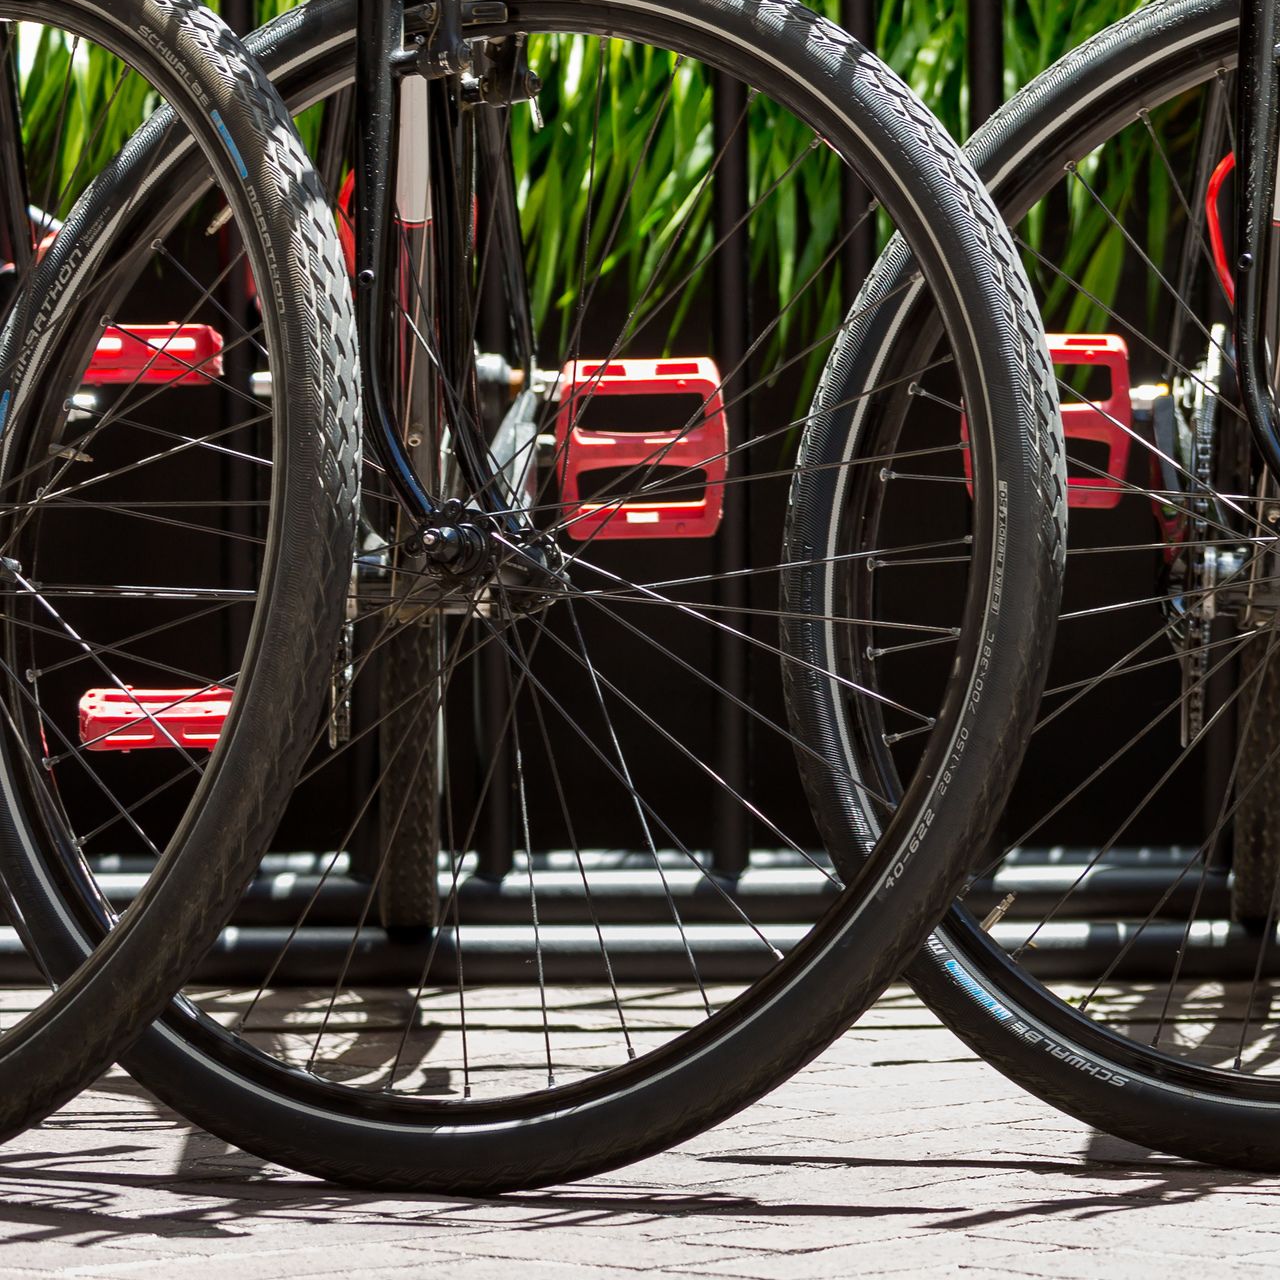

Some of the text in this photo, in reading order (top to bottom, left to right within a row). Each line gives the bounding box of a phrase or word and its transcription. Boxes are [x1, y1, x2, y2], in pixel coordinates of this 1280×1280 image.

[137, 24, 287, 315] SCHWALBE MARATHON
[884, 807, 936, 890] 40-622
[1010, 1020, 1131, 1088] SCHWALBE
